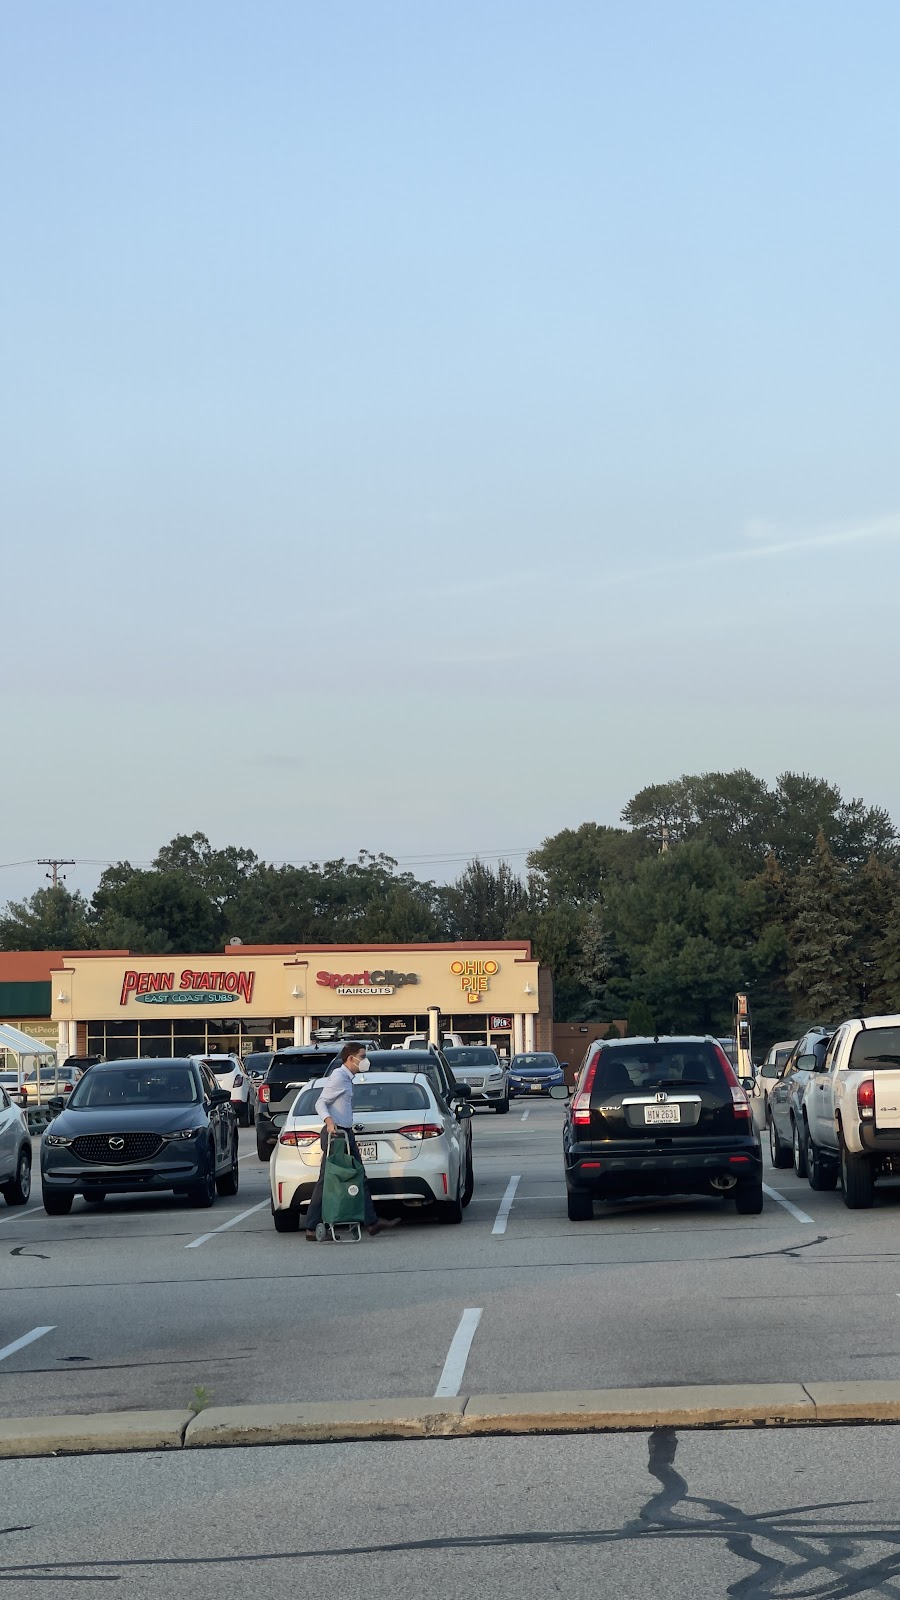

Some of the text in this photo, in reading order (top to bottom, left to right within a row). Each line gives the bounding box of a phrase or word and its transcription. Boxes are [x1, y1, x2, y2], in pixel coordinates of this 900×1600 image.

[450, 960, 498, 975] OHIO
[120, 970, 255, 1005] PENN STATION
[461, 976, 488, 990] PIE
[144, 994, 233, 1003] EAST COAST SUBS
[493, 1017, 508, 1028] OPEN
[661, 1109, 677, 1119] 2631
